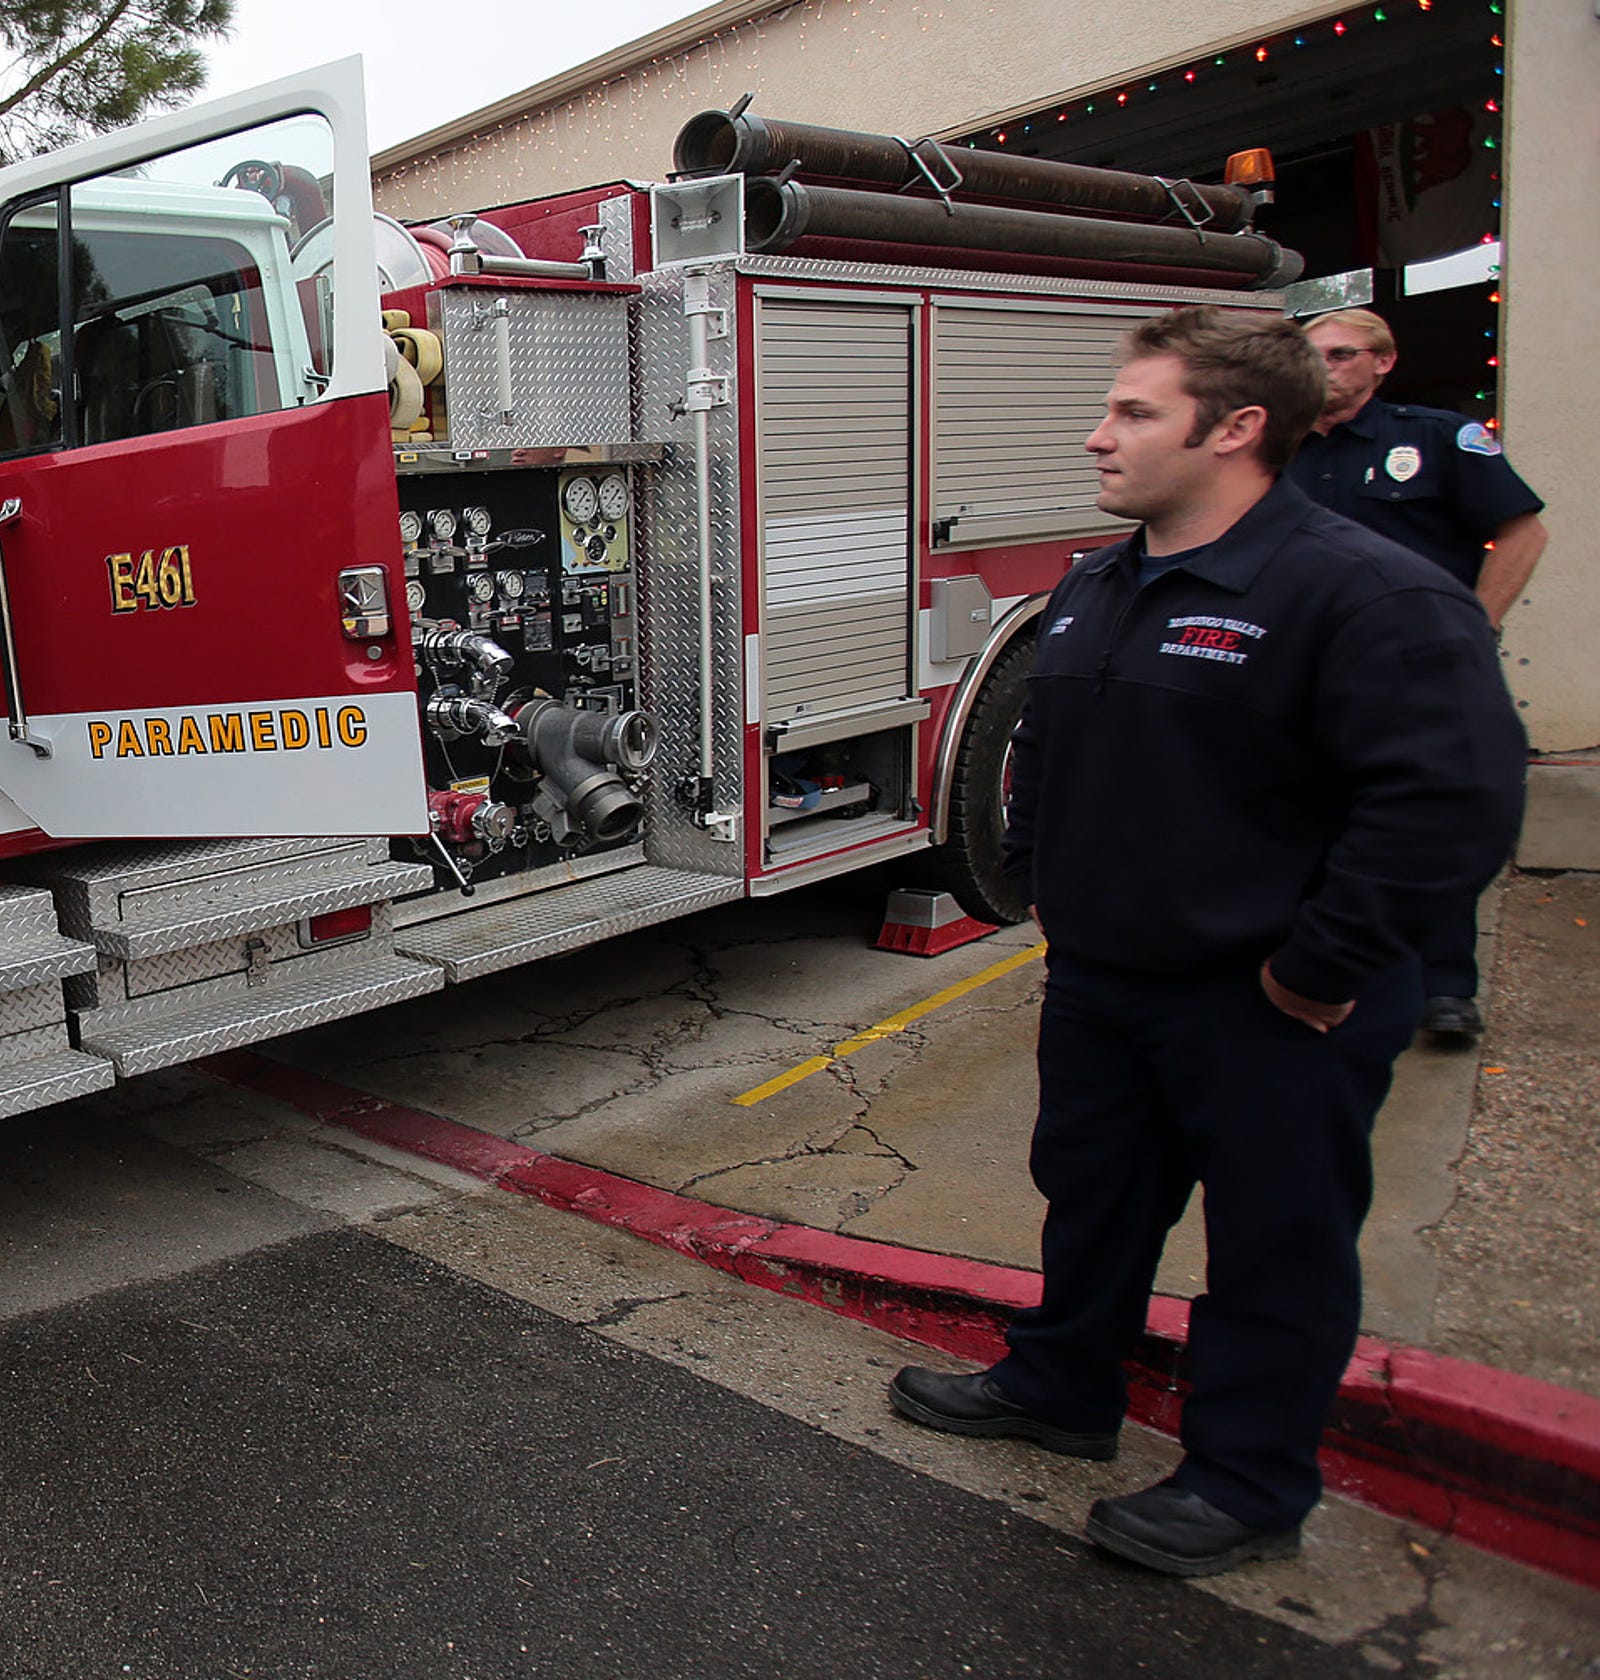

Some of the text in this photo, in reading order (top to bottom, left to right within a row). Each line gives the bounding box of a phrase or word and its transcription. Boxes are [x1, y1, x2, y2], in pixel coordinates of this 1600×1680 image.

[106, 544, 198, 615] E461
[1178, 626, 1241, 650] FIRE
[1222, 617, 1267, 639] VALLEY
[1159, 642, 1248, 664] DEPARTMENT
[87, 704, 369, 760] PARAMEDIC
